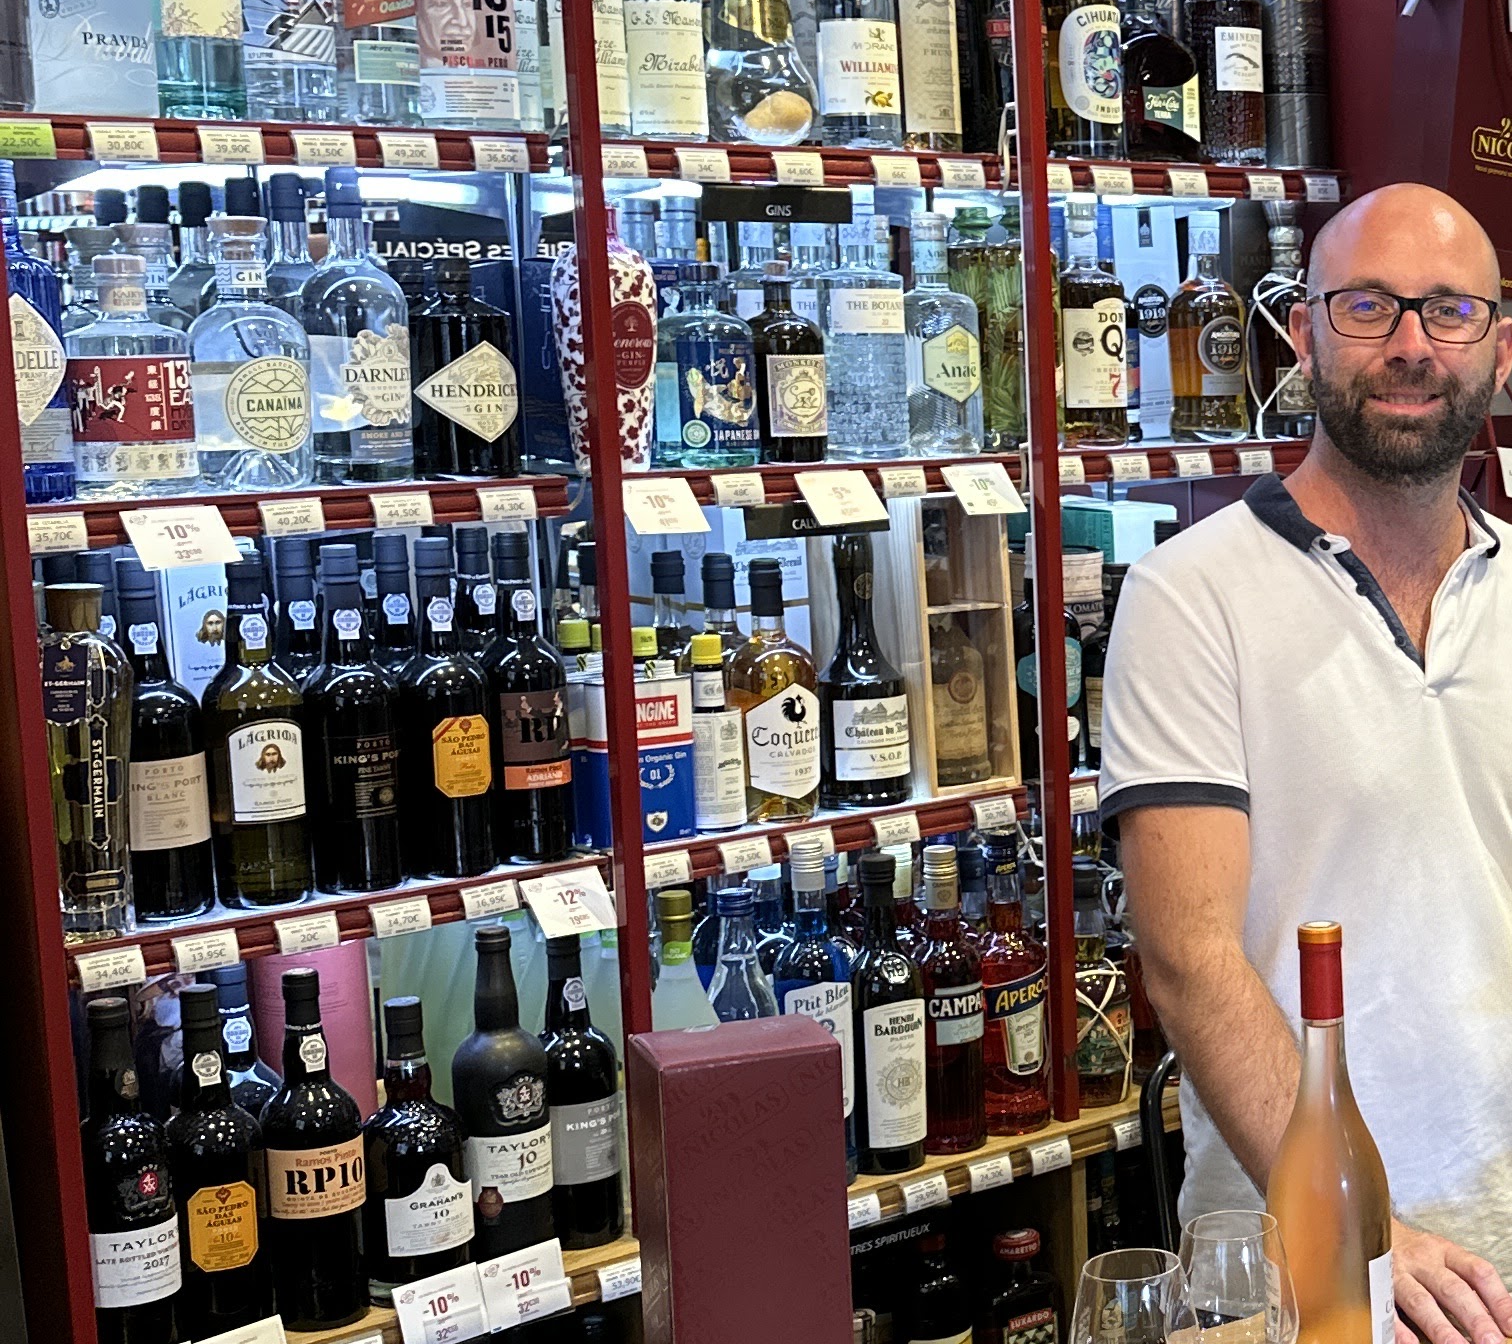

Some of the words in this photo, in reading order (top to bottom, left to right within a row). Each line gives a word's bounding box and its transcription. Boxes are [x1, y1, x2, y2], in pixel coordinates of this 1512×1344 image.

[83, 31, 148, 49] PRAVDA
[107, 139, 144, 152] 30,80€
[215, 142, 250, 154] 39,90€
[766, 204, 792, 217] GINS
[236, 271, 262, 283] GIN
[1138, 306, 1166, 322] 1919
[1101, 324, 1124, 363] Q
[1210, 342, 1241, 356] 1919
[1109, 373, 1122, 398] 7
[246, 395, 303, 413] CANAÏMA
[474, 404, 504, 414] GIN
[493, 500, 526, 514] 44,30€
[277, 513, 312, 526] 40,20€
[34, 530, 75, 544] 35,70€
[156, 522, 201, 541] -10%
[145, 765, 185, 776] PORTO
[90, 738, 104, 819] ST-GERMAIN
[146, 790, 187, 802] BLANC
[475, 894, 507, 909] 16,95€
[553, 888, 586, 907] -12%
[387, 914, 419, 927] 14,70€
[300, 933, 319, 943] 20€
[191, 948, 227, 962] 13,95€
[94, 966, 132, 980] 34,40€
[889, 1014, 915, 1026] HENRI
[517, 1150, 538, 1170] 10
[285, 1156, 363, 1196] RP10
[409, 1191, 464, 1211] GRAHAM'S
[432, 1208, 450, 1220] 10
[874, 1222, 931, 1248] SPIRITUEUX
[143, 1255, 171, 1271] 2017
[505, 1265, 542, 1291] -10%
[422, 1291, 460, 1316] -10%
